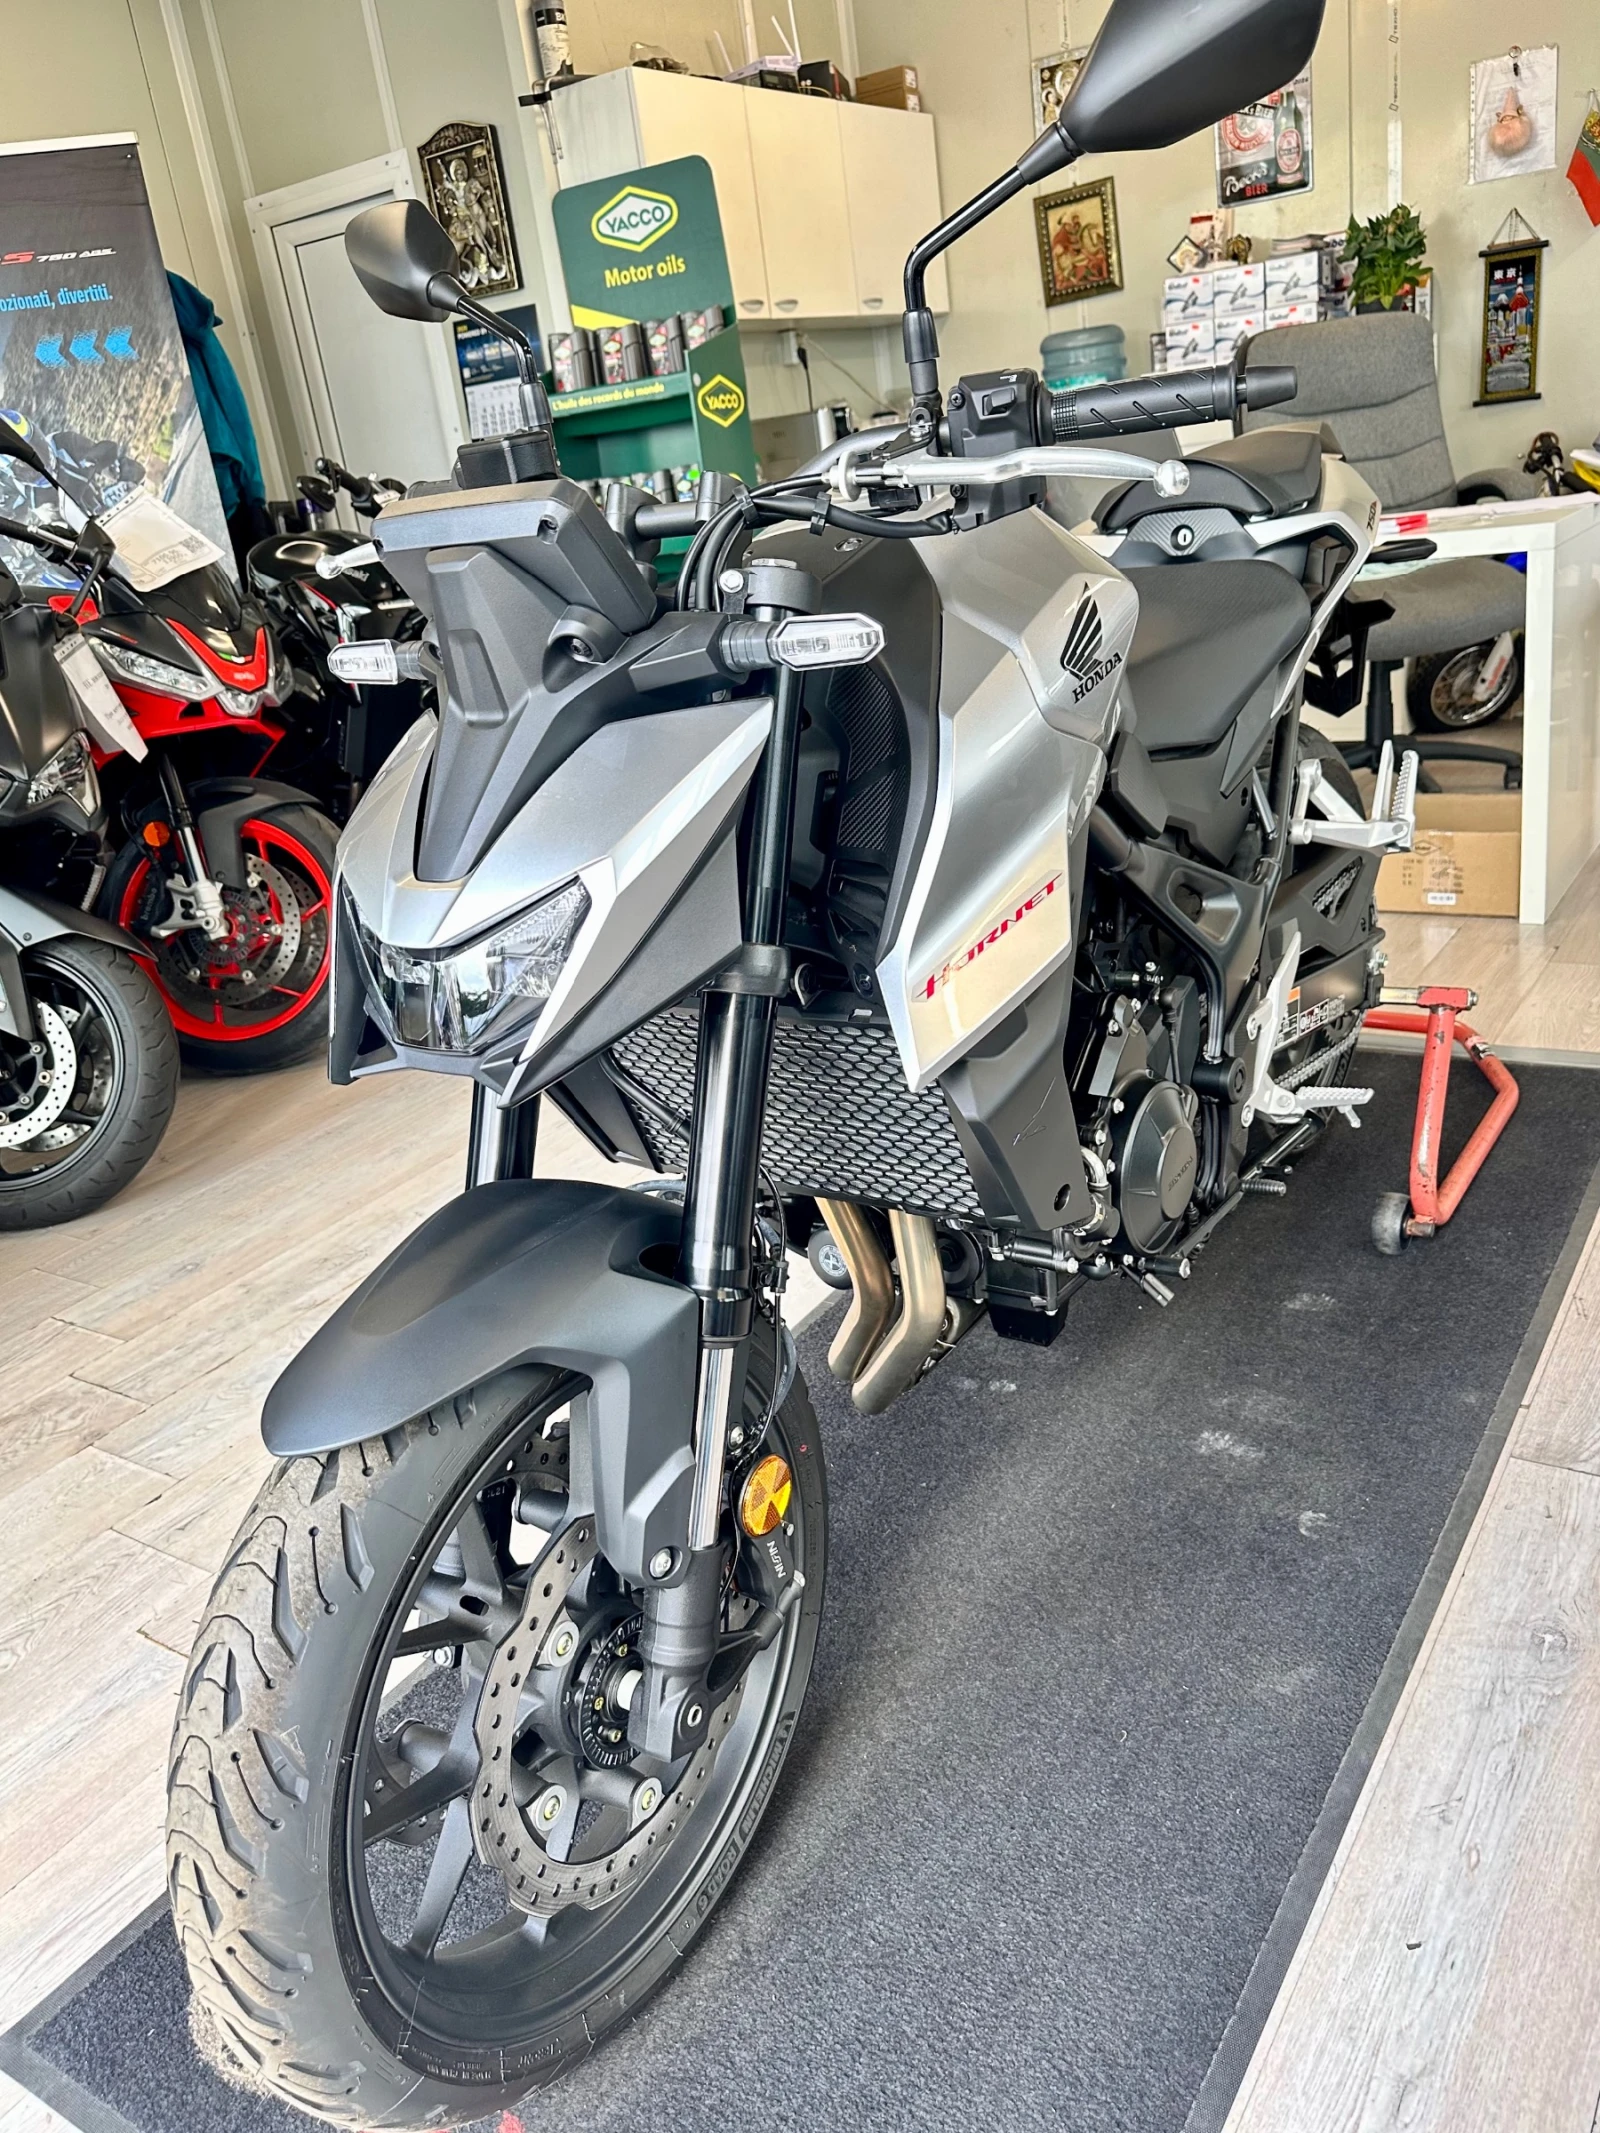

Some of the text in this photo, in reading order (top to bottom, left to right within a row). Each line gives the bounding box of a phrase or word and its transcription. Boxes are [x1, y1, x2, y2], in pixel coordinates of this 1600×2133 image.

[1245, 183, 1268, 197] BIER
[605, 205, 665, 233] YACCO
[604, 254, 686, 288] Motor oils
[57, 283, 113, 305] divertiti.
[704, 393, 738, 410] YACCO
[1072, 651, 1123, 704] HONDA
[916, 871, 1063, 999] HORNET
[766, 1540, 787, 1578] NISSIN
[742, 1739, 784, 1836] MICHELIN
[706, 1847, 740, 1895] ROAD
